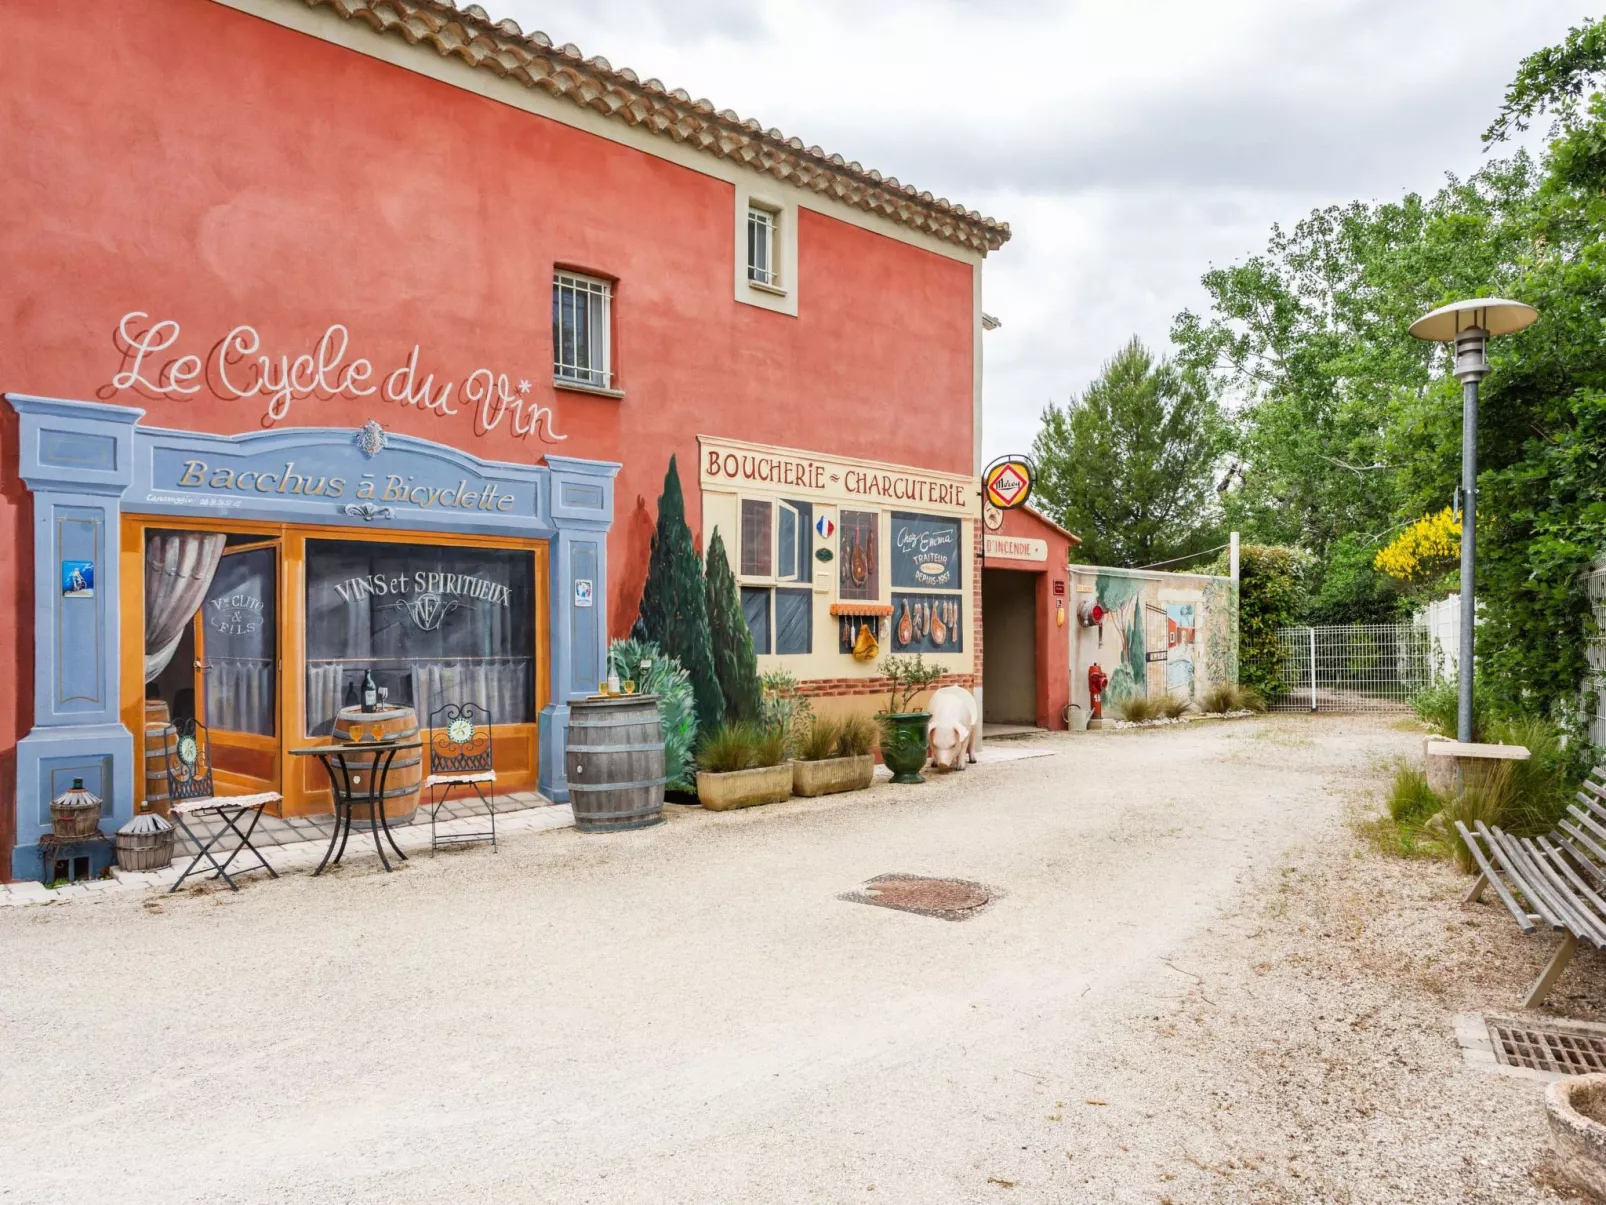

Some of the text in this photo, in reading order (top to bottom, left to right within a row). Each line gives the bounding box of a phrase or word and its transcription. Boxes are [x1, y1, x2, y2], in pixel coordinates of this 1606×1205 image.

[112, 311, 567, 440] Le Cycle du Vin
[176, 459, 347, 499] Bacchus
[382, 473, 516, 513] Bicyclette
[706, 450, 966, 507] BOUCHERIE CHARCUTERIE
[912, 552, 948, 565] TRAITEUR
[334, 571, 513, 607] VINS et SPIRITUEUX
[218, 622, 256, 635] FILS
[231, 610, 242, 622] &
